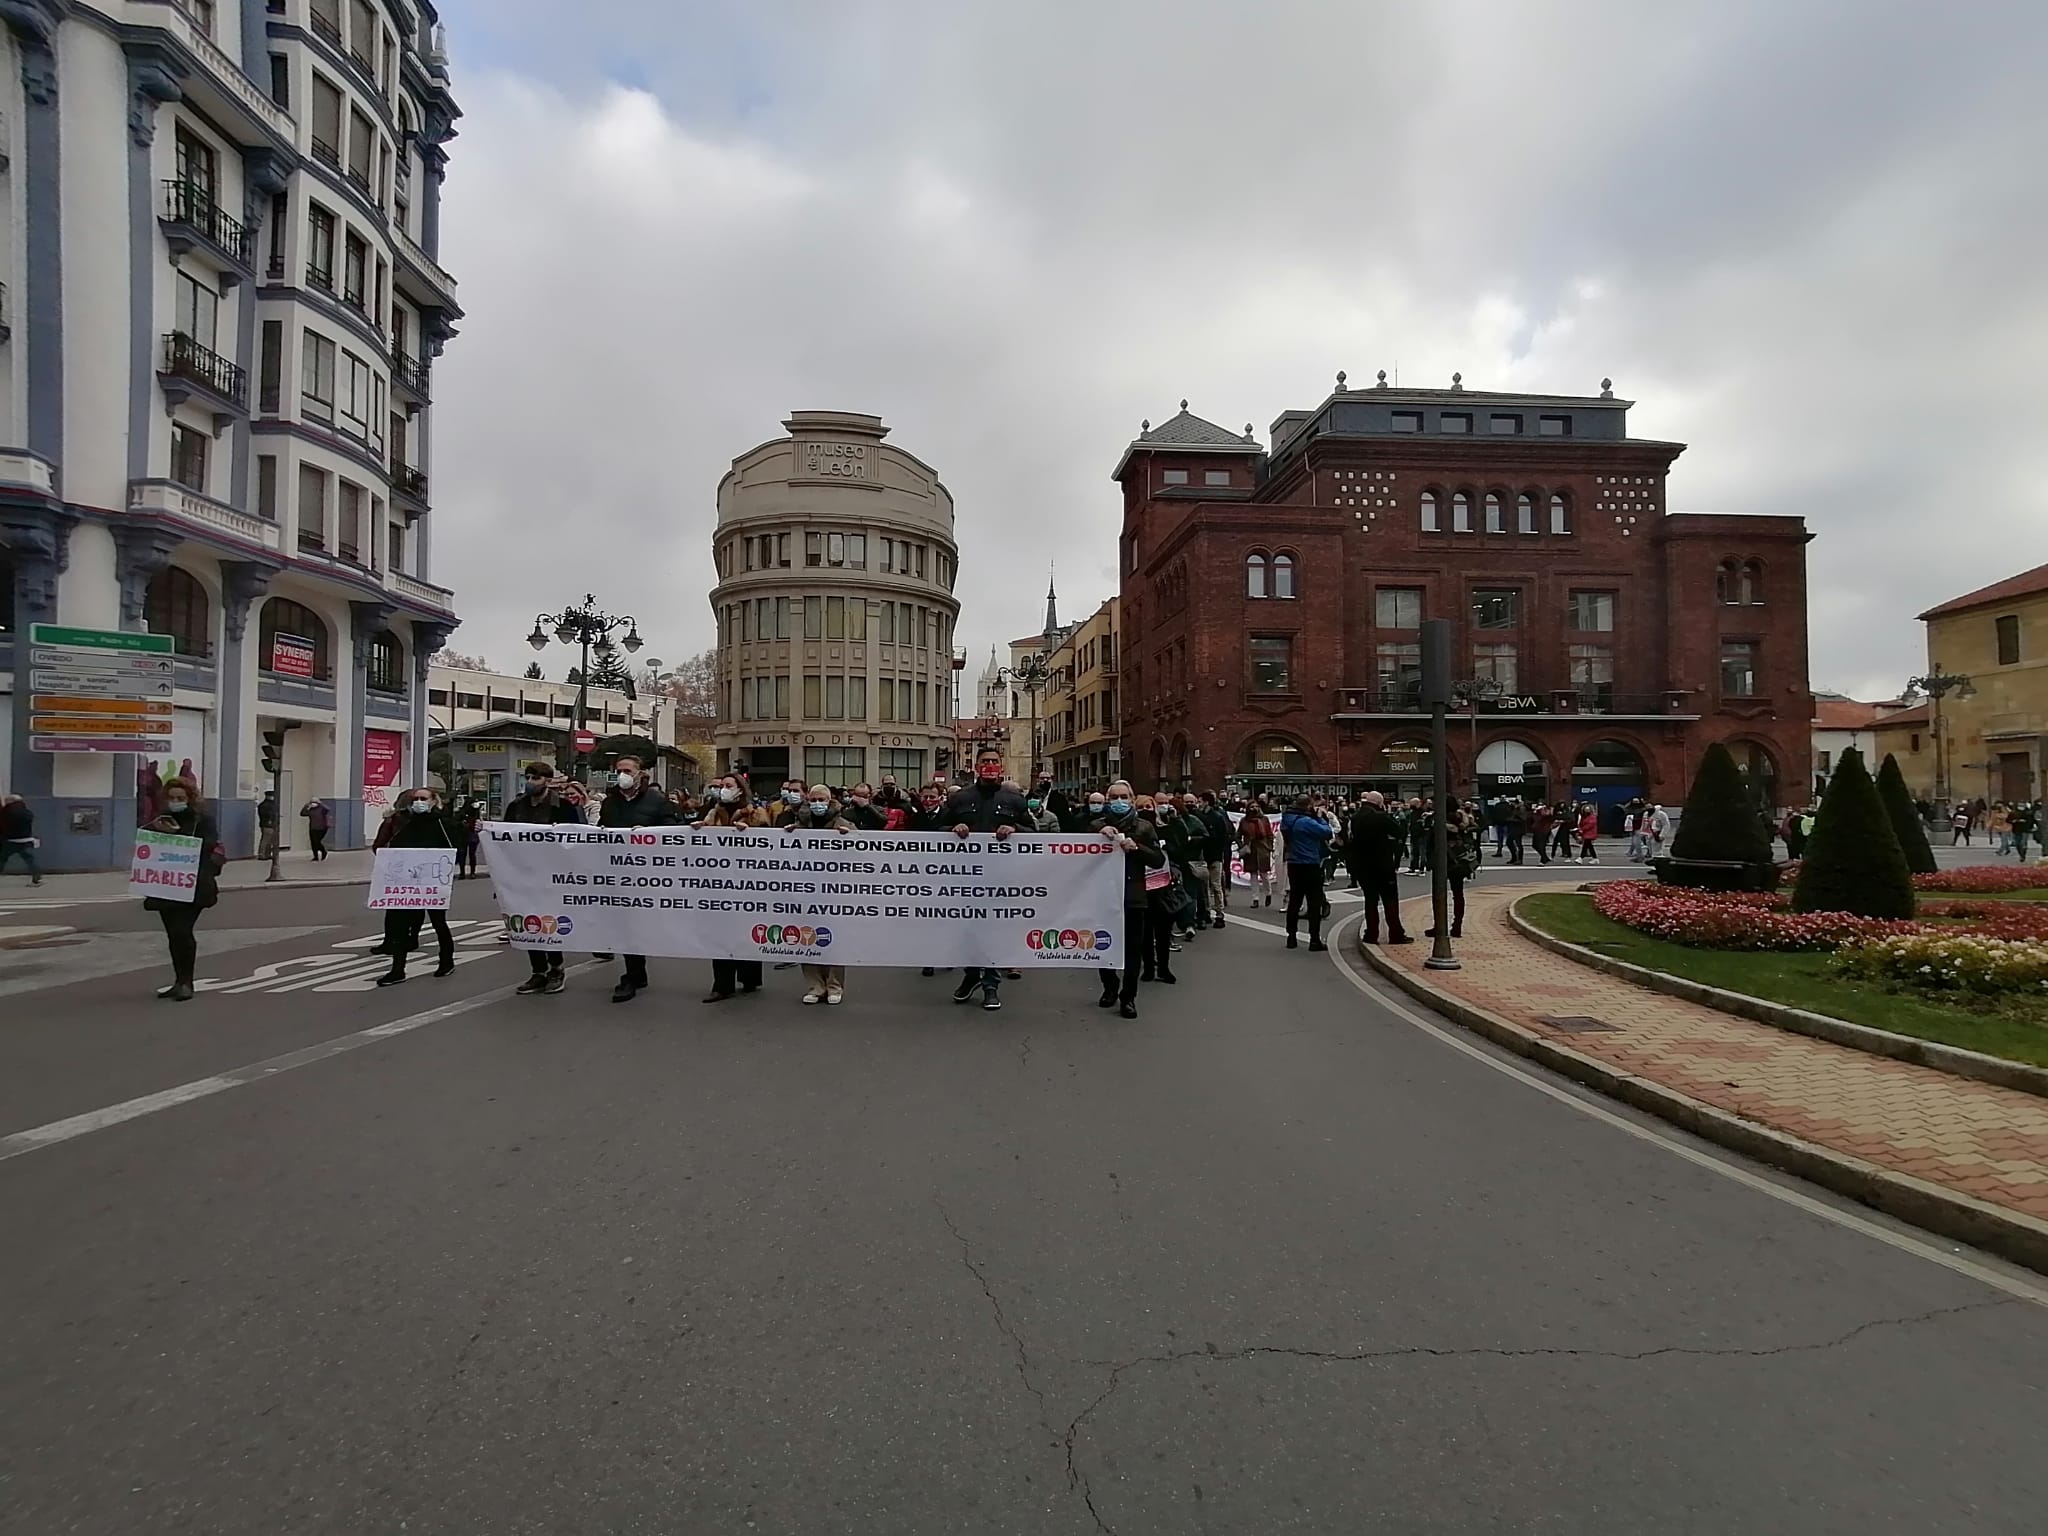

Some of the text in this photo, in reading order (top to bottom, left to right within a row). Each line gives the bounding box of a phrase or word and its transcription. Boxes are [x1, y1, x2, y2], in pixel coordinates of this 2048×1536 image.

[807, 443, 865, 459] museo
[820, 458, 864, 478] León
[1498, 696, 1537, 709] BBVA
[752, 734, 815, 745] MUSEO
[831, 734, 854, 745] DE
[478, 744, 503, 752] ONCE
[1256, 761, 1284, 771] BBVA
[1391, 762, 1417, 772] BBVA
[1497, 775, 1525, 784] BBVA
[1265, 785, 1300, 796] PUMA
[491, 831, 1113, 854] LA HOSTELERÍA NO ES EL VIRUS, LA RESPONSABILIDAD ES DE TODOS
[610, 853, 983, 875] MÁS DE 1.000 TRABAJADORES A LA CALLE
[552, 872, 1048, 897] MÁS DE 2.000 TRABAJADORES INDIRECTOS AFECTADOS
[384, 886, 438, 895] BASTA DE
[370, 898, 447, 907] ASFIXIARNOS
[563, 894, 1036, 919] EMPRESAS DEL SECTOR SIN AYUDAS DE NINGÚN TIPO
